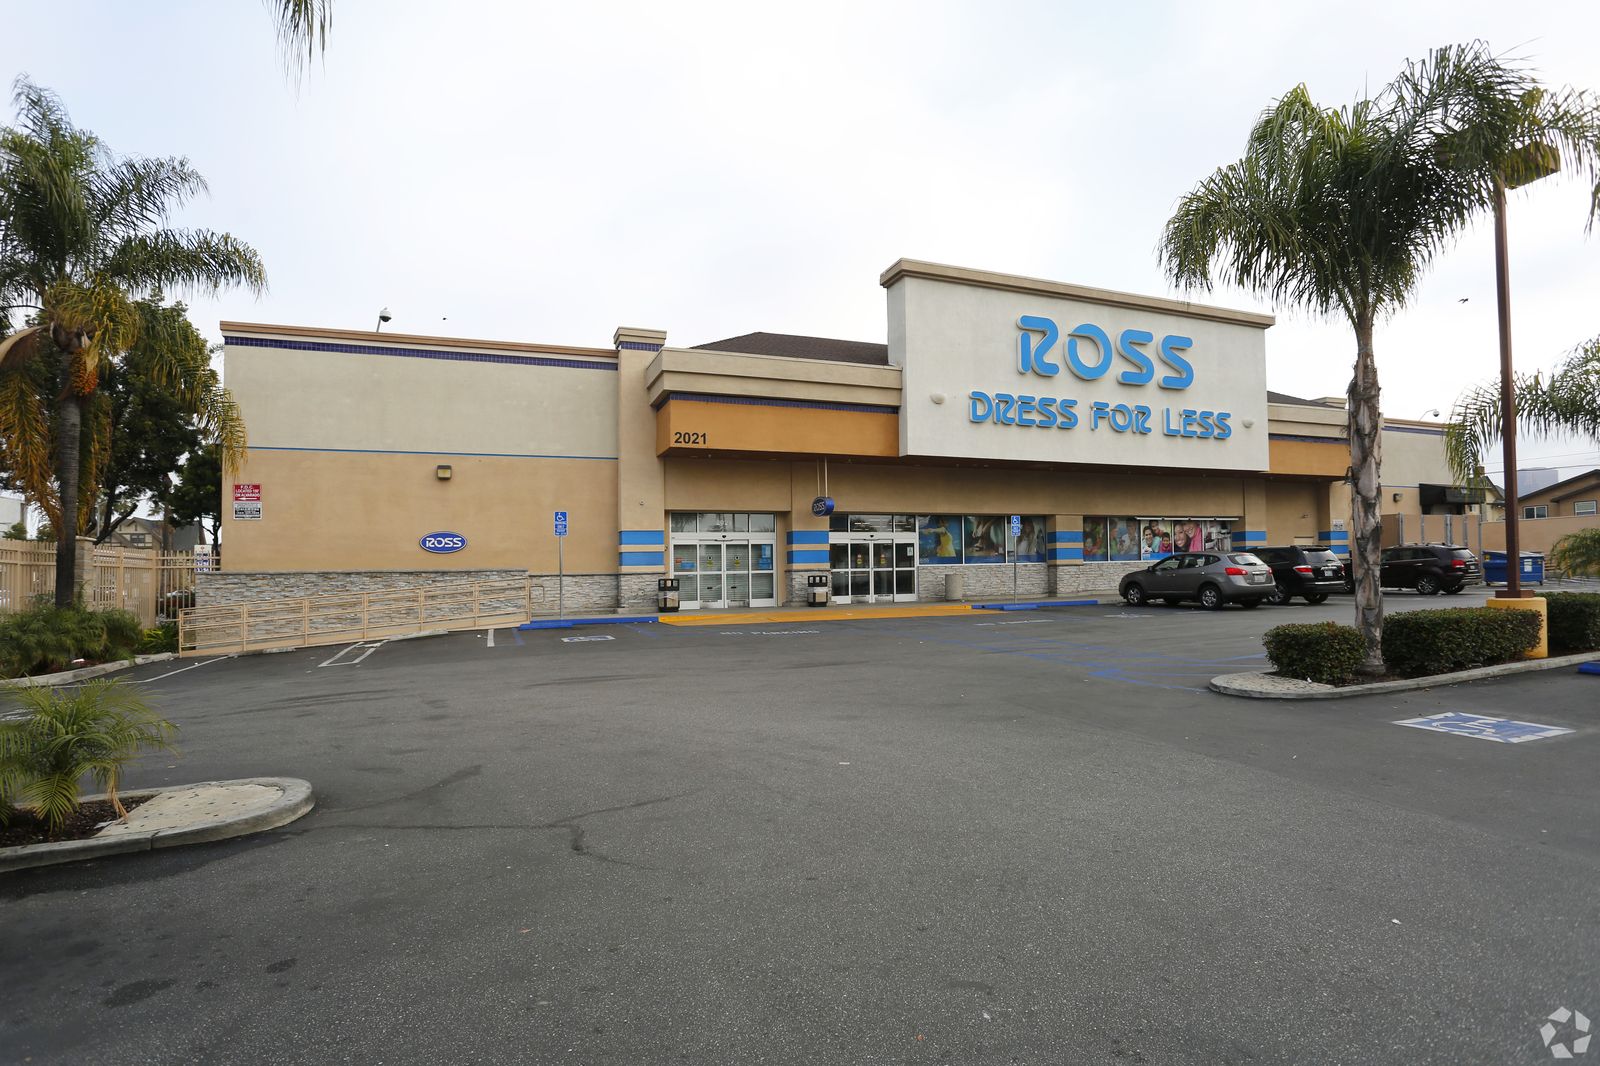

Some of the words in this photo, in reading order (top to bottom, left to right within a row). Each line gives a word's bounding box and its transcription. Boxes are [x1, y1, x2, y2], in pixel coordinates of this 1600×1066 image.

[1016, 314, 1195, 390] ROSS
[969, 390, 1079, 429] DRESS
[1090, 401, 1152, 434] FOR
[1163, 407, 1232, 439] LESS
[674, 431, 707, 445] 2021
[425, 537, 462, 548] ROSS
